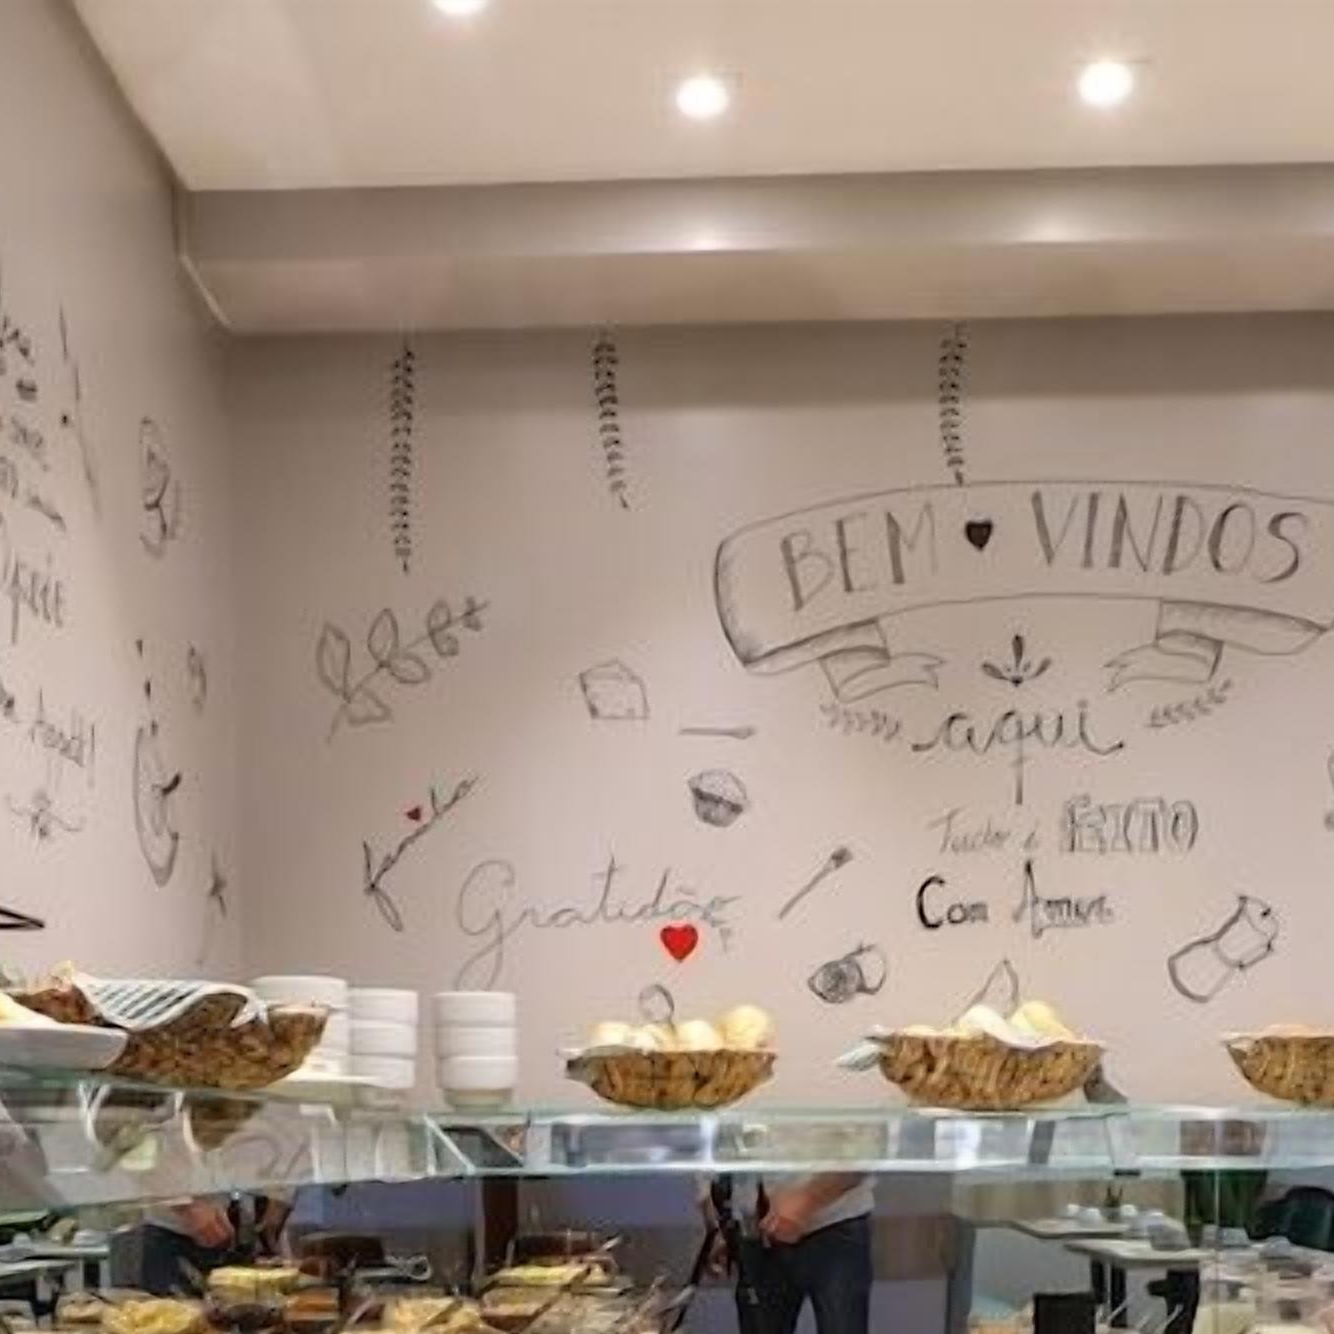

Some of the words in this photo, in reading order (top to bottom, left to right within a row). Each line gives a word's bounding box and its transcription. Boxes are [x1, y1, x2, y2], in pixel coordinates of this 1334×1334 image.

[779, 501, 939, 612] BEM
[1031, 491, 1310, 584] VINDOS
[911, 699, 1124, 804] aqui
